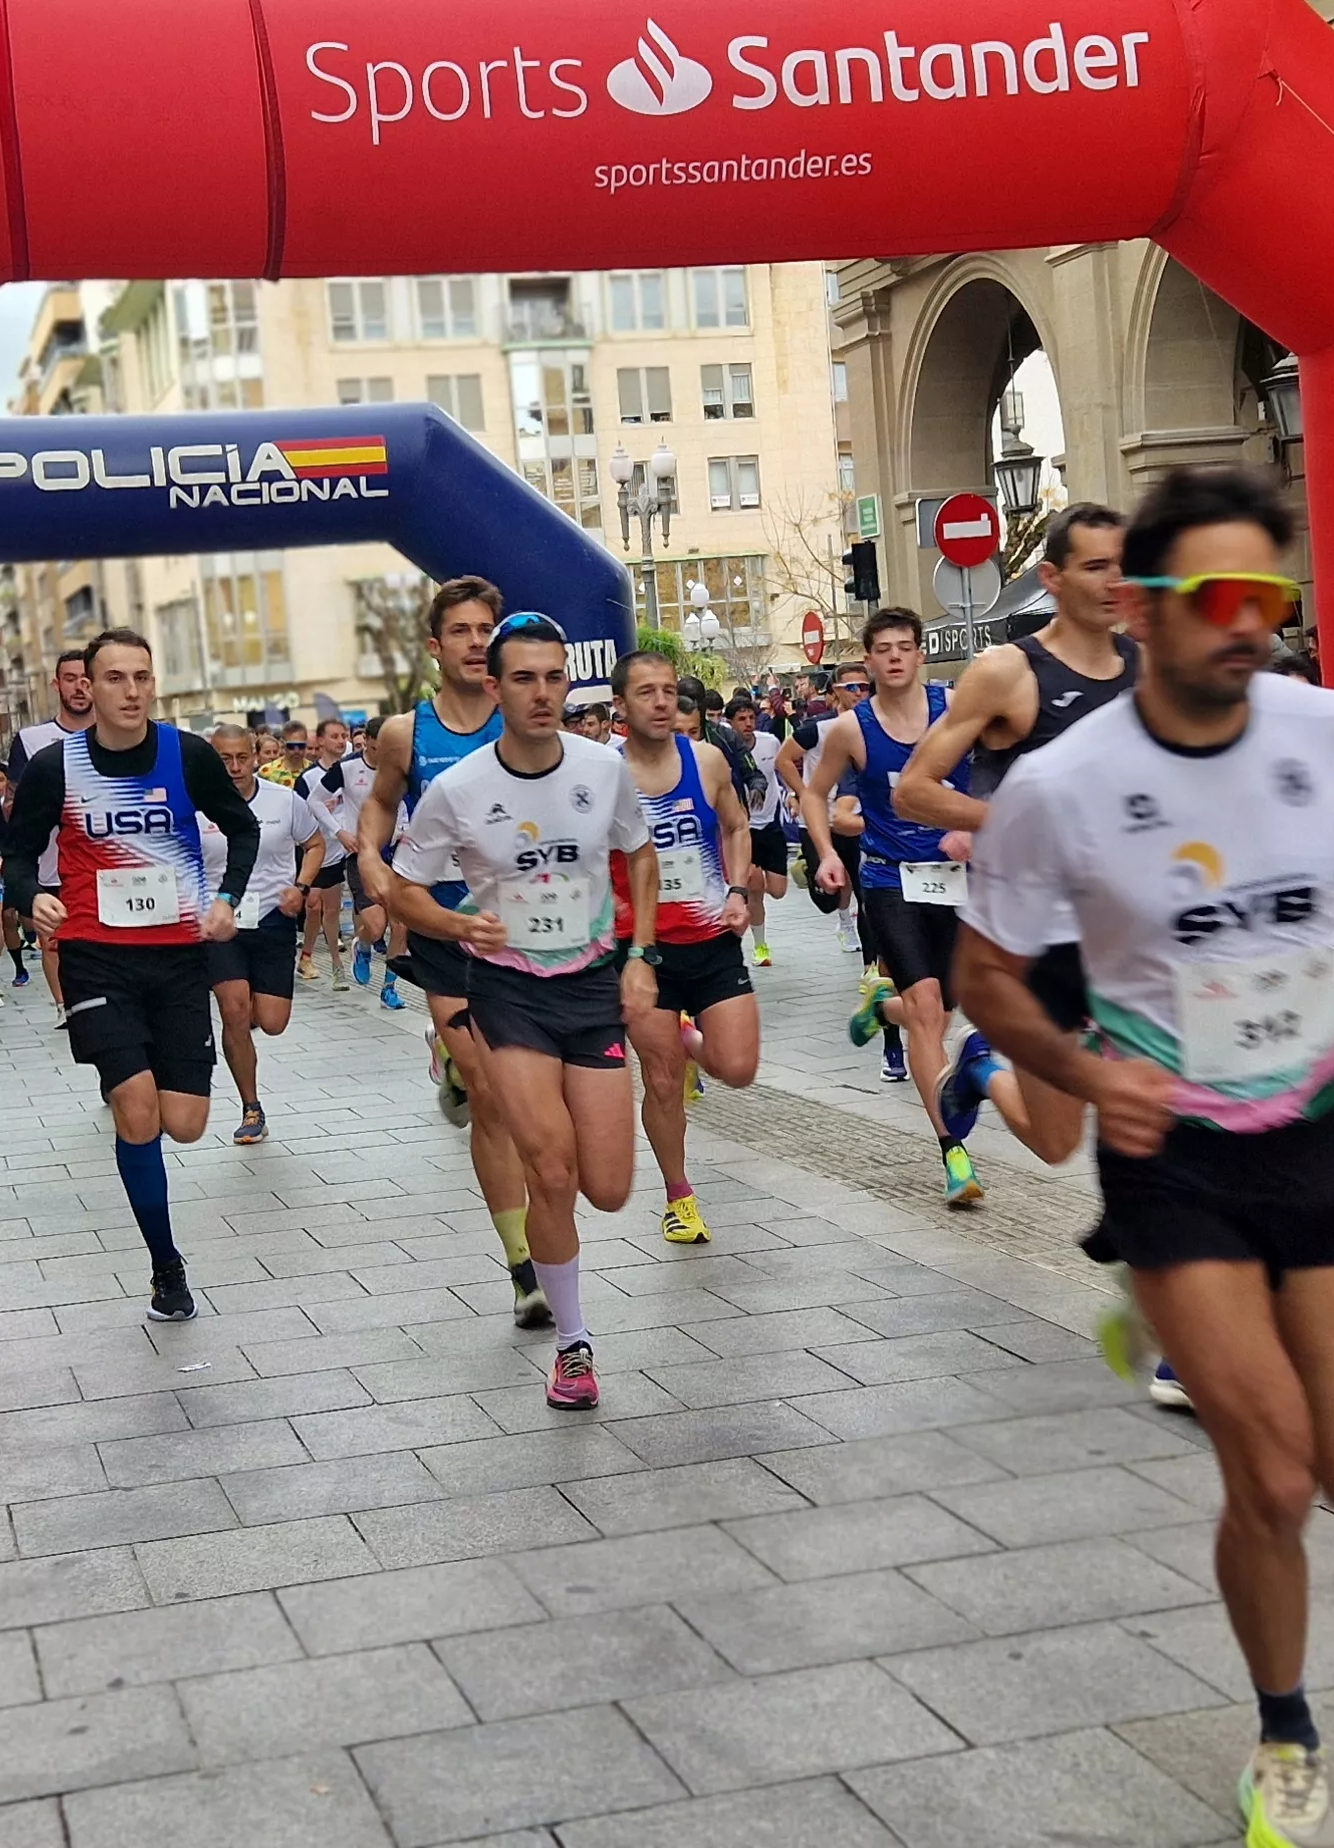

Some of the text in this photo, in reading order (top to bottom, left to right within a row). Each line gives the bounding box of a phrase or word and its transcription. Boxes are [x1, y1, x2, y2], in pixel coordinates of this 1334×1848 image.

[305, 22, 1149, 144] Sports Santander
[594, 148, 873, 193] sportssantander.es
[170, 475, 389, 508] NACIONAL
[85, 809, 172, 838] USA
[649, 816, 700, 849] SA
[517, 844, 579, 871] SYB
[922, 882, 947, 894] 225
[126, 897, 155, 911] 130
[528, 916, 565, 934] 231
